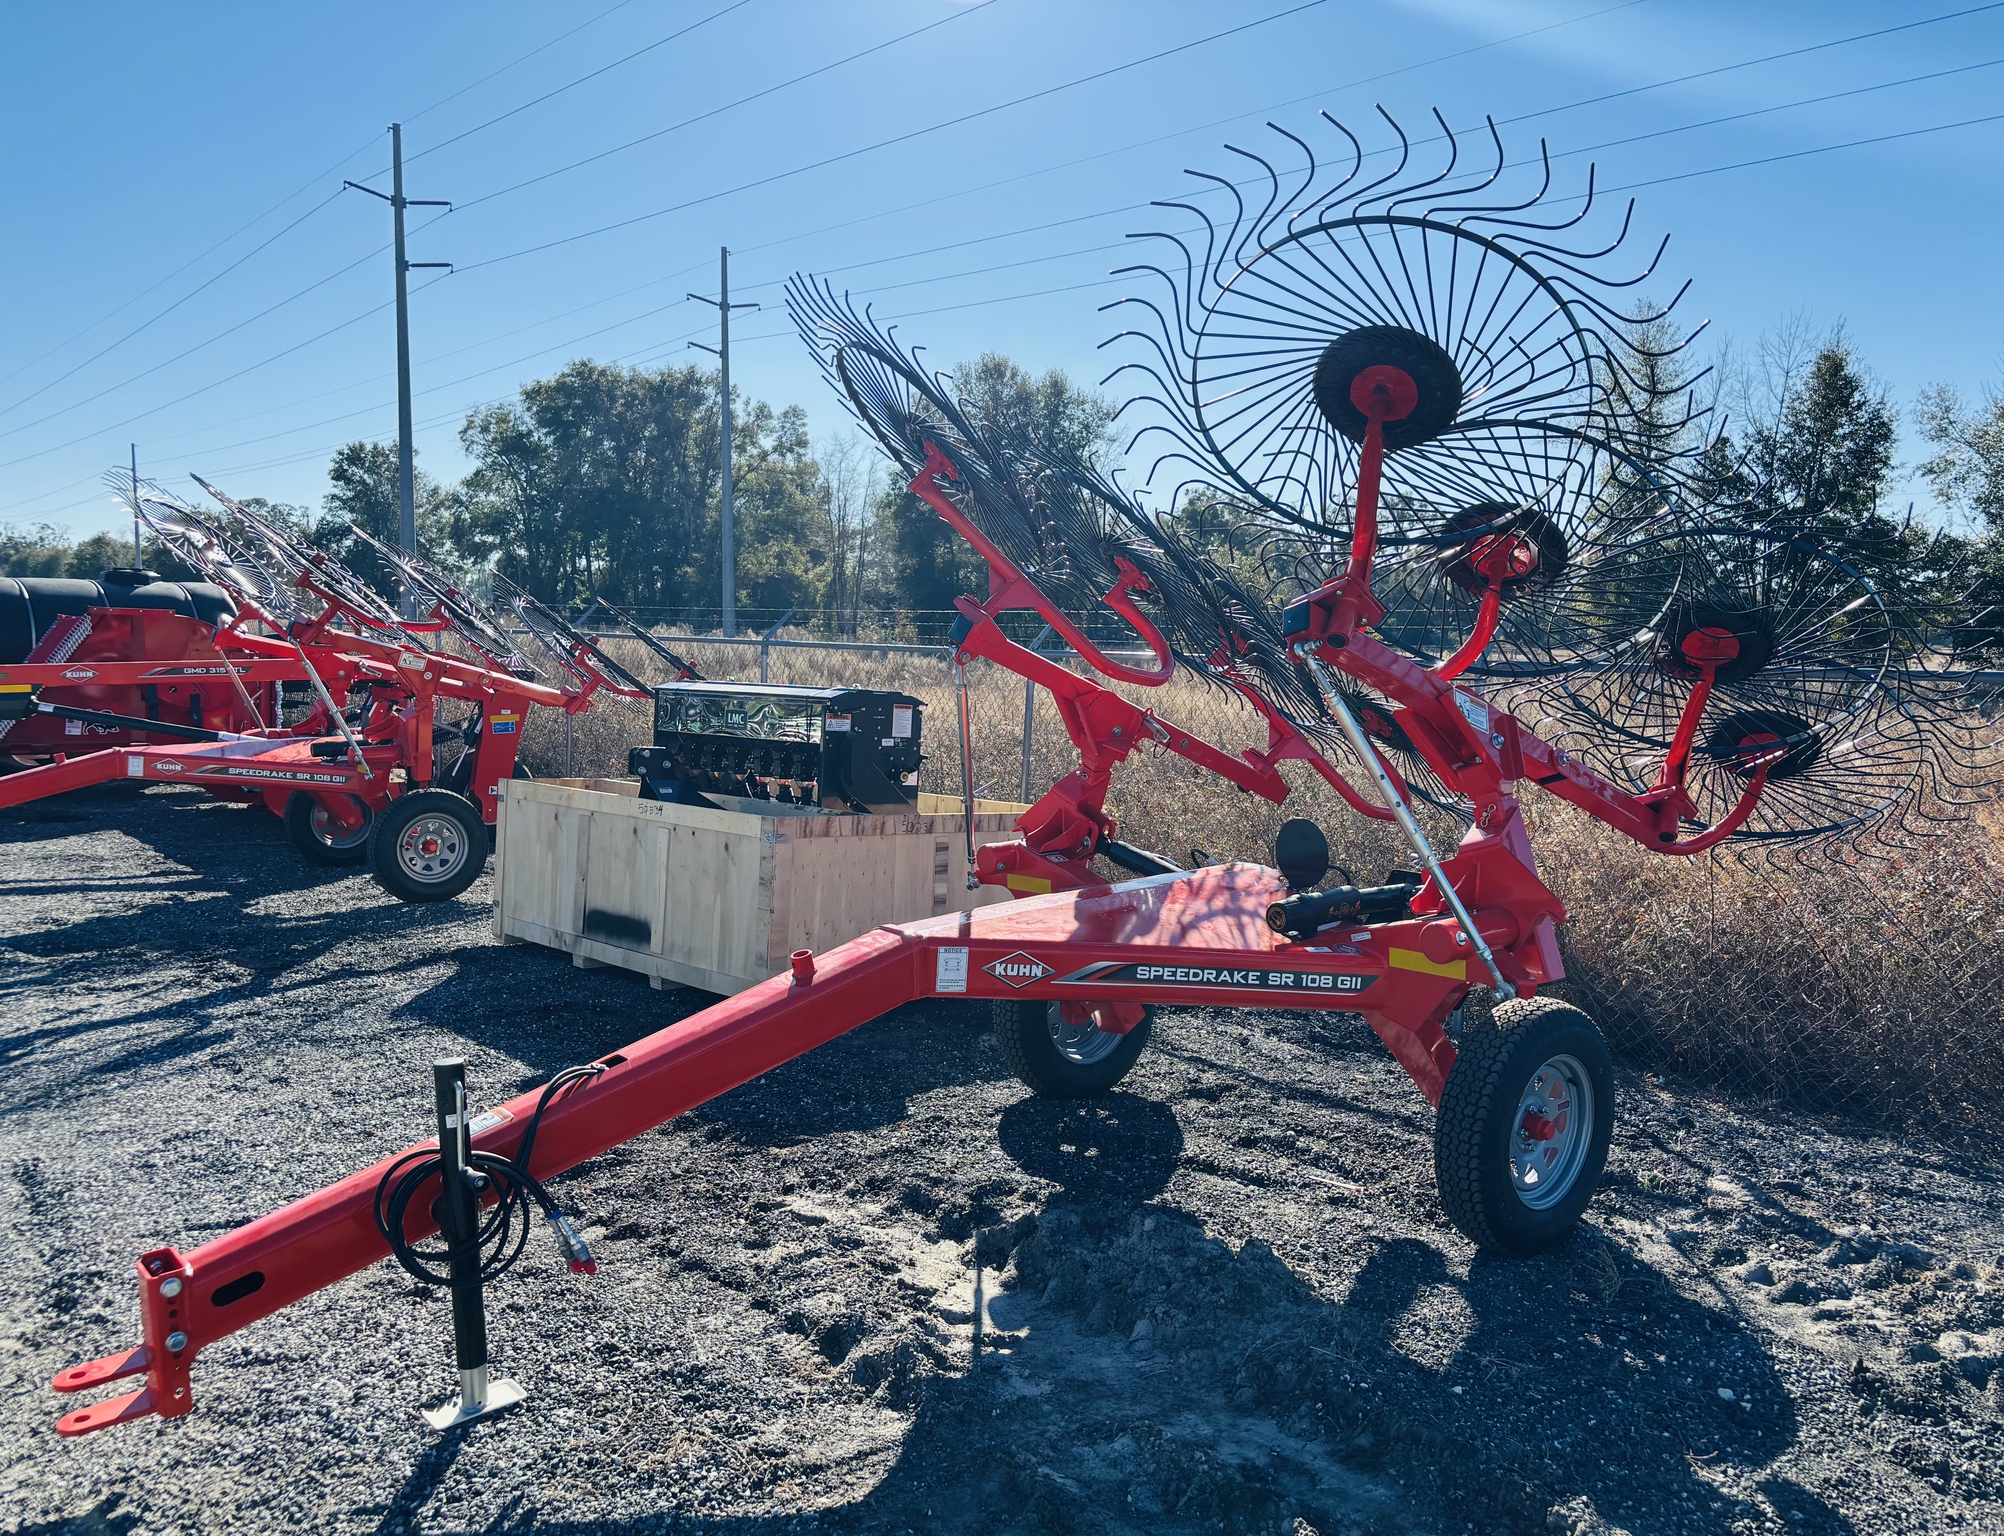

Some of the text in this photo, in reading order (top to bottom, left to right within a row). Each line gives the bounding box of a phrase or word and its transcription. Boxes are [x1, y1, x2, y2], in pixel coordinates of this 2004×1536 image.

[727, 712, 745, 724] LMC
[228, 767, 293, 779] SPEEDRAKE
[296, 772, 311, 780] SR
[995, 963, 1043, 977] KUHN
[1136, 966, 1362, 989] SPEEDRAKE SR 108 GII
